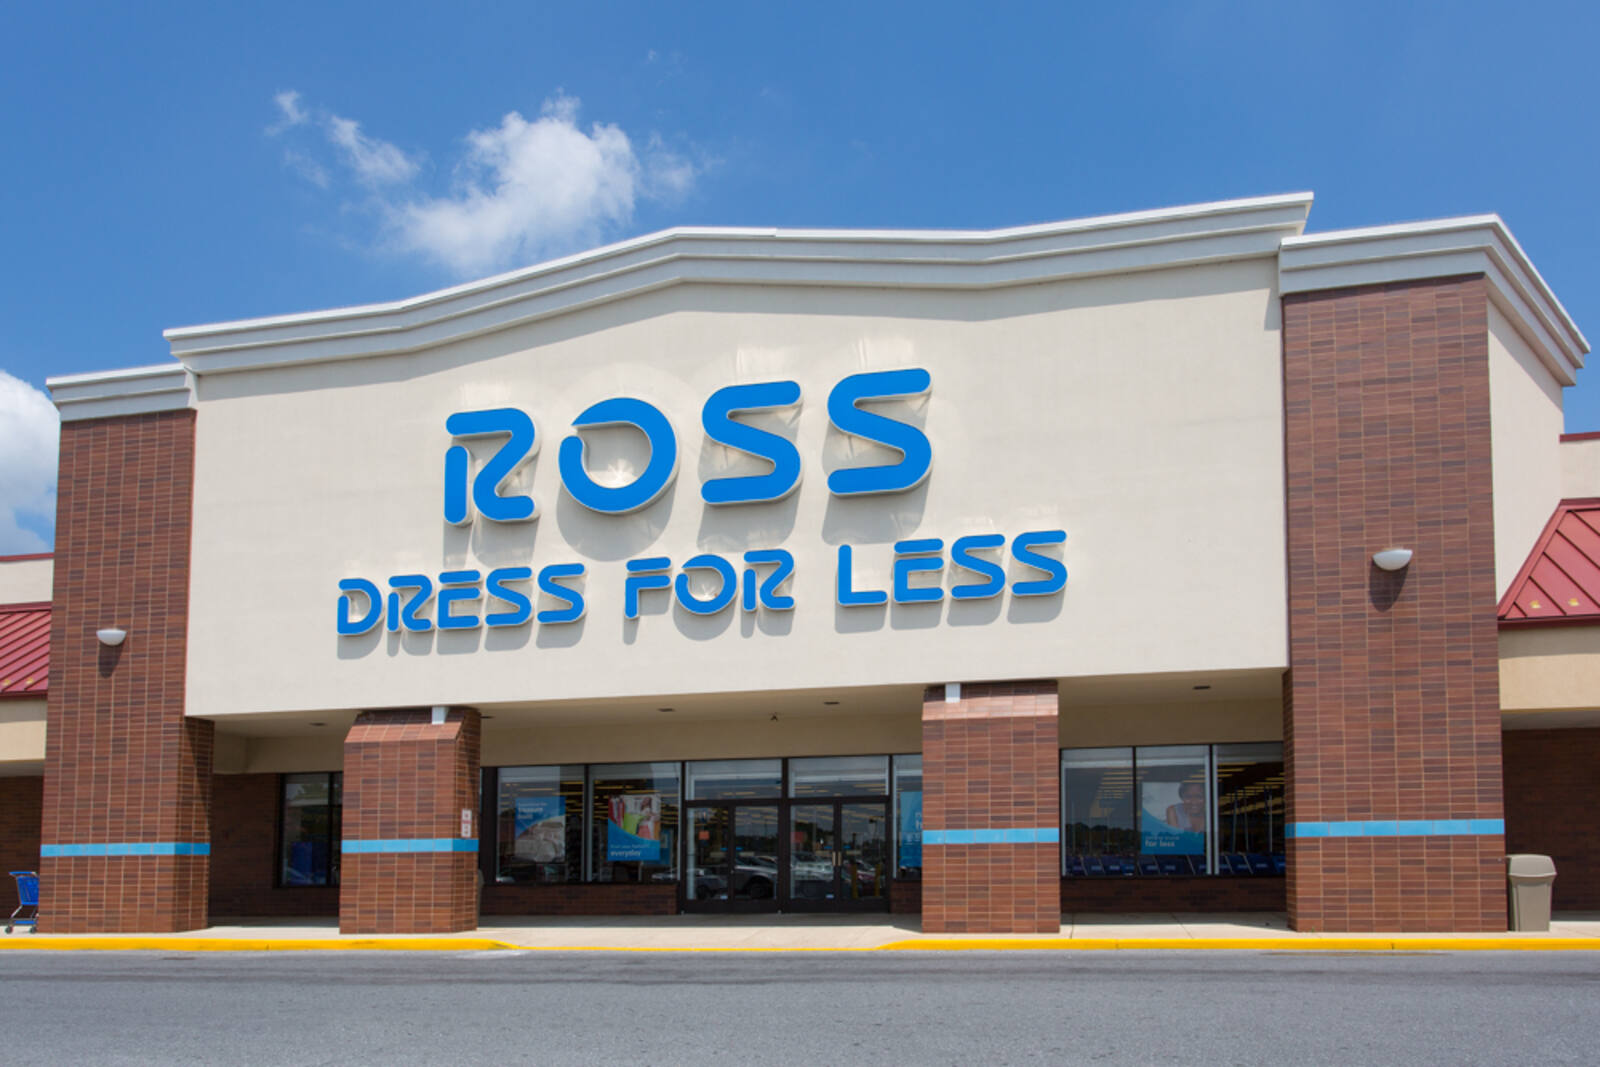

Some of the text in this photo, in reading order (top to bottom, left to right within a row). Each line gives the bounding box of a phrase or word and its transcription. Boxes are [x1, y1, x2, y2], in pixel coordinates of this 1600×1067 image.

[444, 368, 932, 525] ROSS
[337, 530, 1068, 636] DRESS FOR LESS
